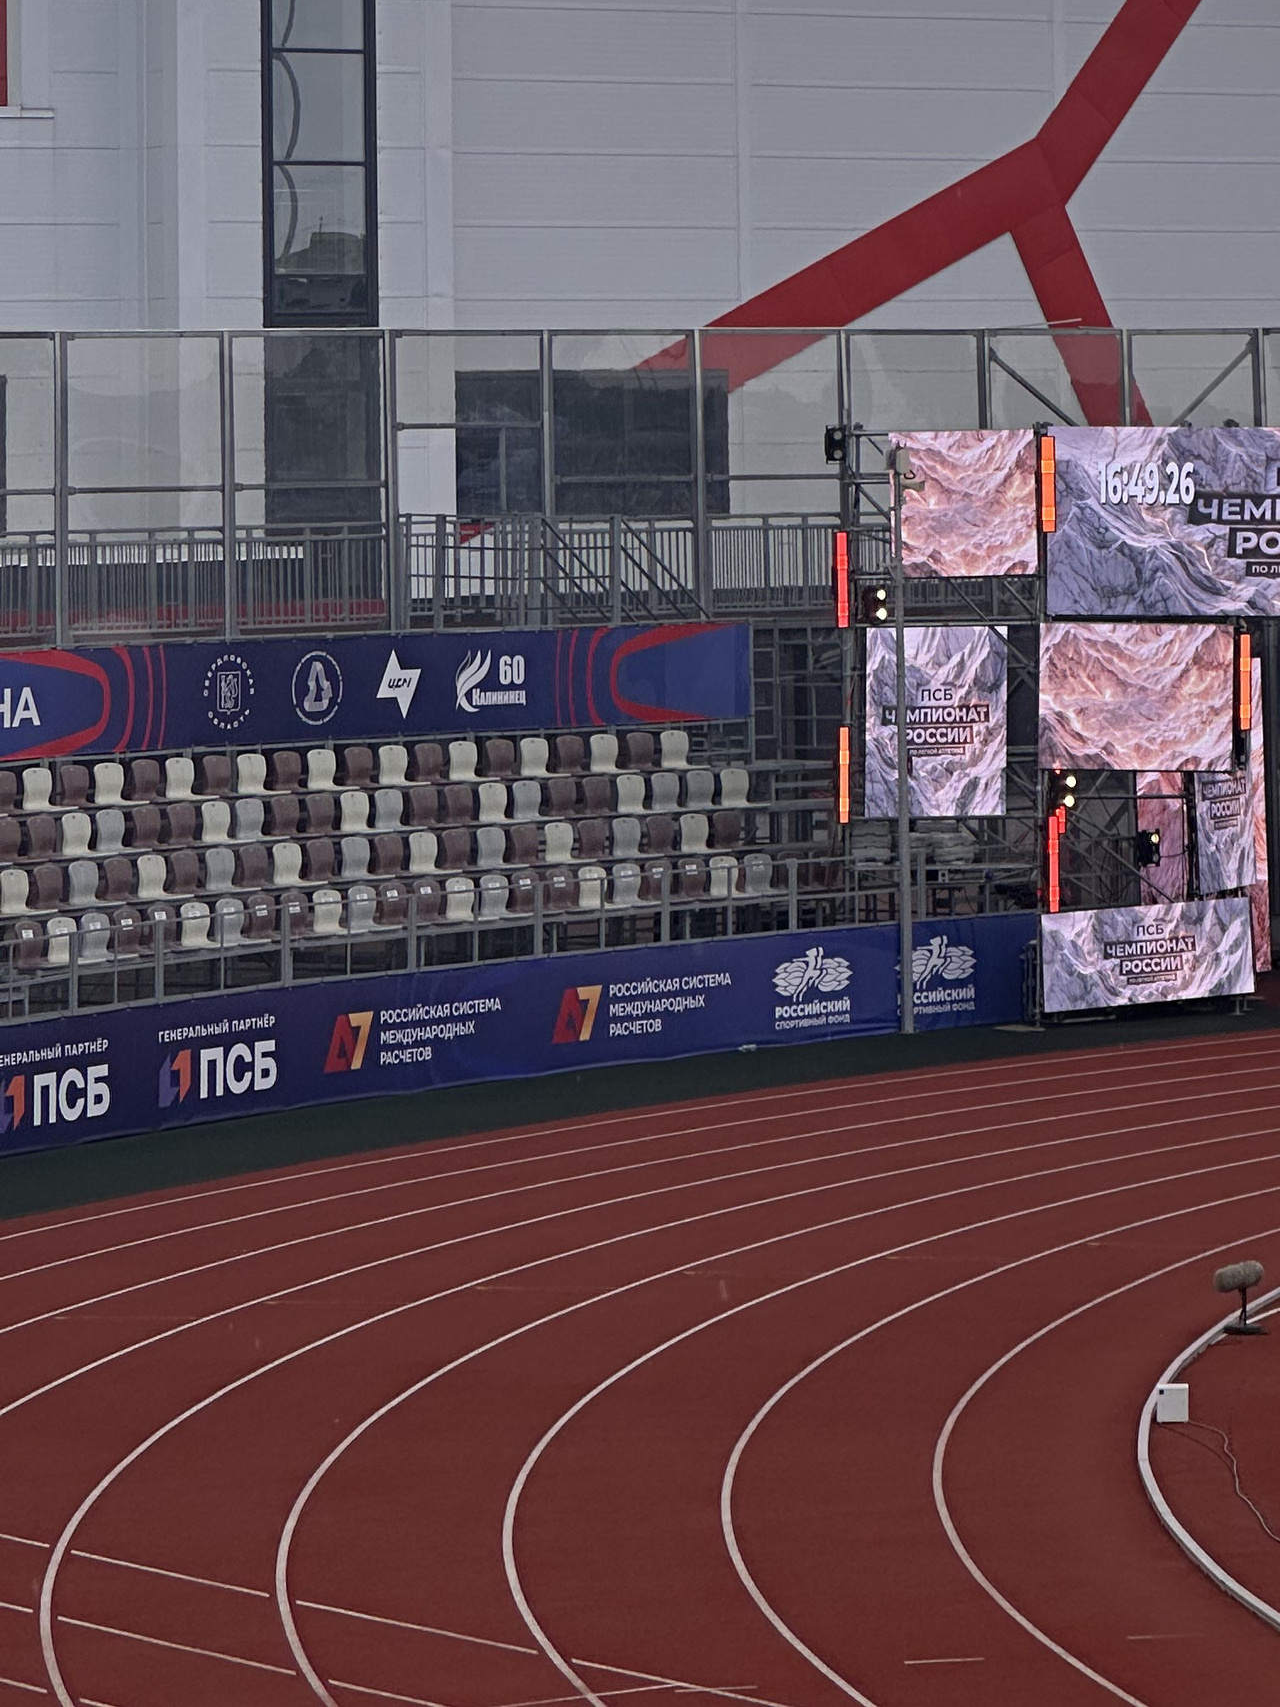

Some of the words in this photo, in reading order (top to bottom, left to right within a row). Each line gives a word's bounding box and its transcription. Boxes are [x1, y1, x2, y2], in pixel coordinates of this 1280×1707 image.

[1099, 462, 1196, 505] 16:49.26
[1252, 565, 1268, 573] ПО
[499, 655, 525, 685] 60
[921, 688, 953, 702] ПСБ
[885, 707, 987, 723] ЧМПИОНАТ
[1136, 924, 1164, 937] ПСБ
[1106, 937, 1194, 956] ЧЕМПИОНАТ
[1122, 956, 1181, 974] РОССИИ
[609, 977, 679, 997] РОССИЙСКАЯ
[681, 973, 732, 990] СИСТЕМА
[897, 984, 975, 1005] ССИЙСКИЙ
[380, 1003, 450, 1024] РОССИЙСКАЯ
[452, 997, 501, 1016] СИСТЕМА
[609, 994, 705, 1017] МЕЖДУНАРОДНЫХ
[775, 996, 850, 1018] РОССИЙСКИЙ
[158, 1019, 229, 1043] ГЕНЕРАЛЬНЫЙ
[232, 1013, 275, 1032] ПАРТНЁР
[380, 1020, 475, 1044] МЕЖДУНАРОДНЫХ
[609, 1018, 662, 1037] РАСЧЕТОВ
[65, 1038, 109, 1056] ПАРТНЁР
[380, 1046, 433, 1065] РАСЧЕТОВ
[200, 1039, 278, 1099] ПСБ
[33, 1063, 111, 1126] ПСБ
